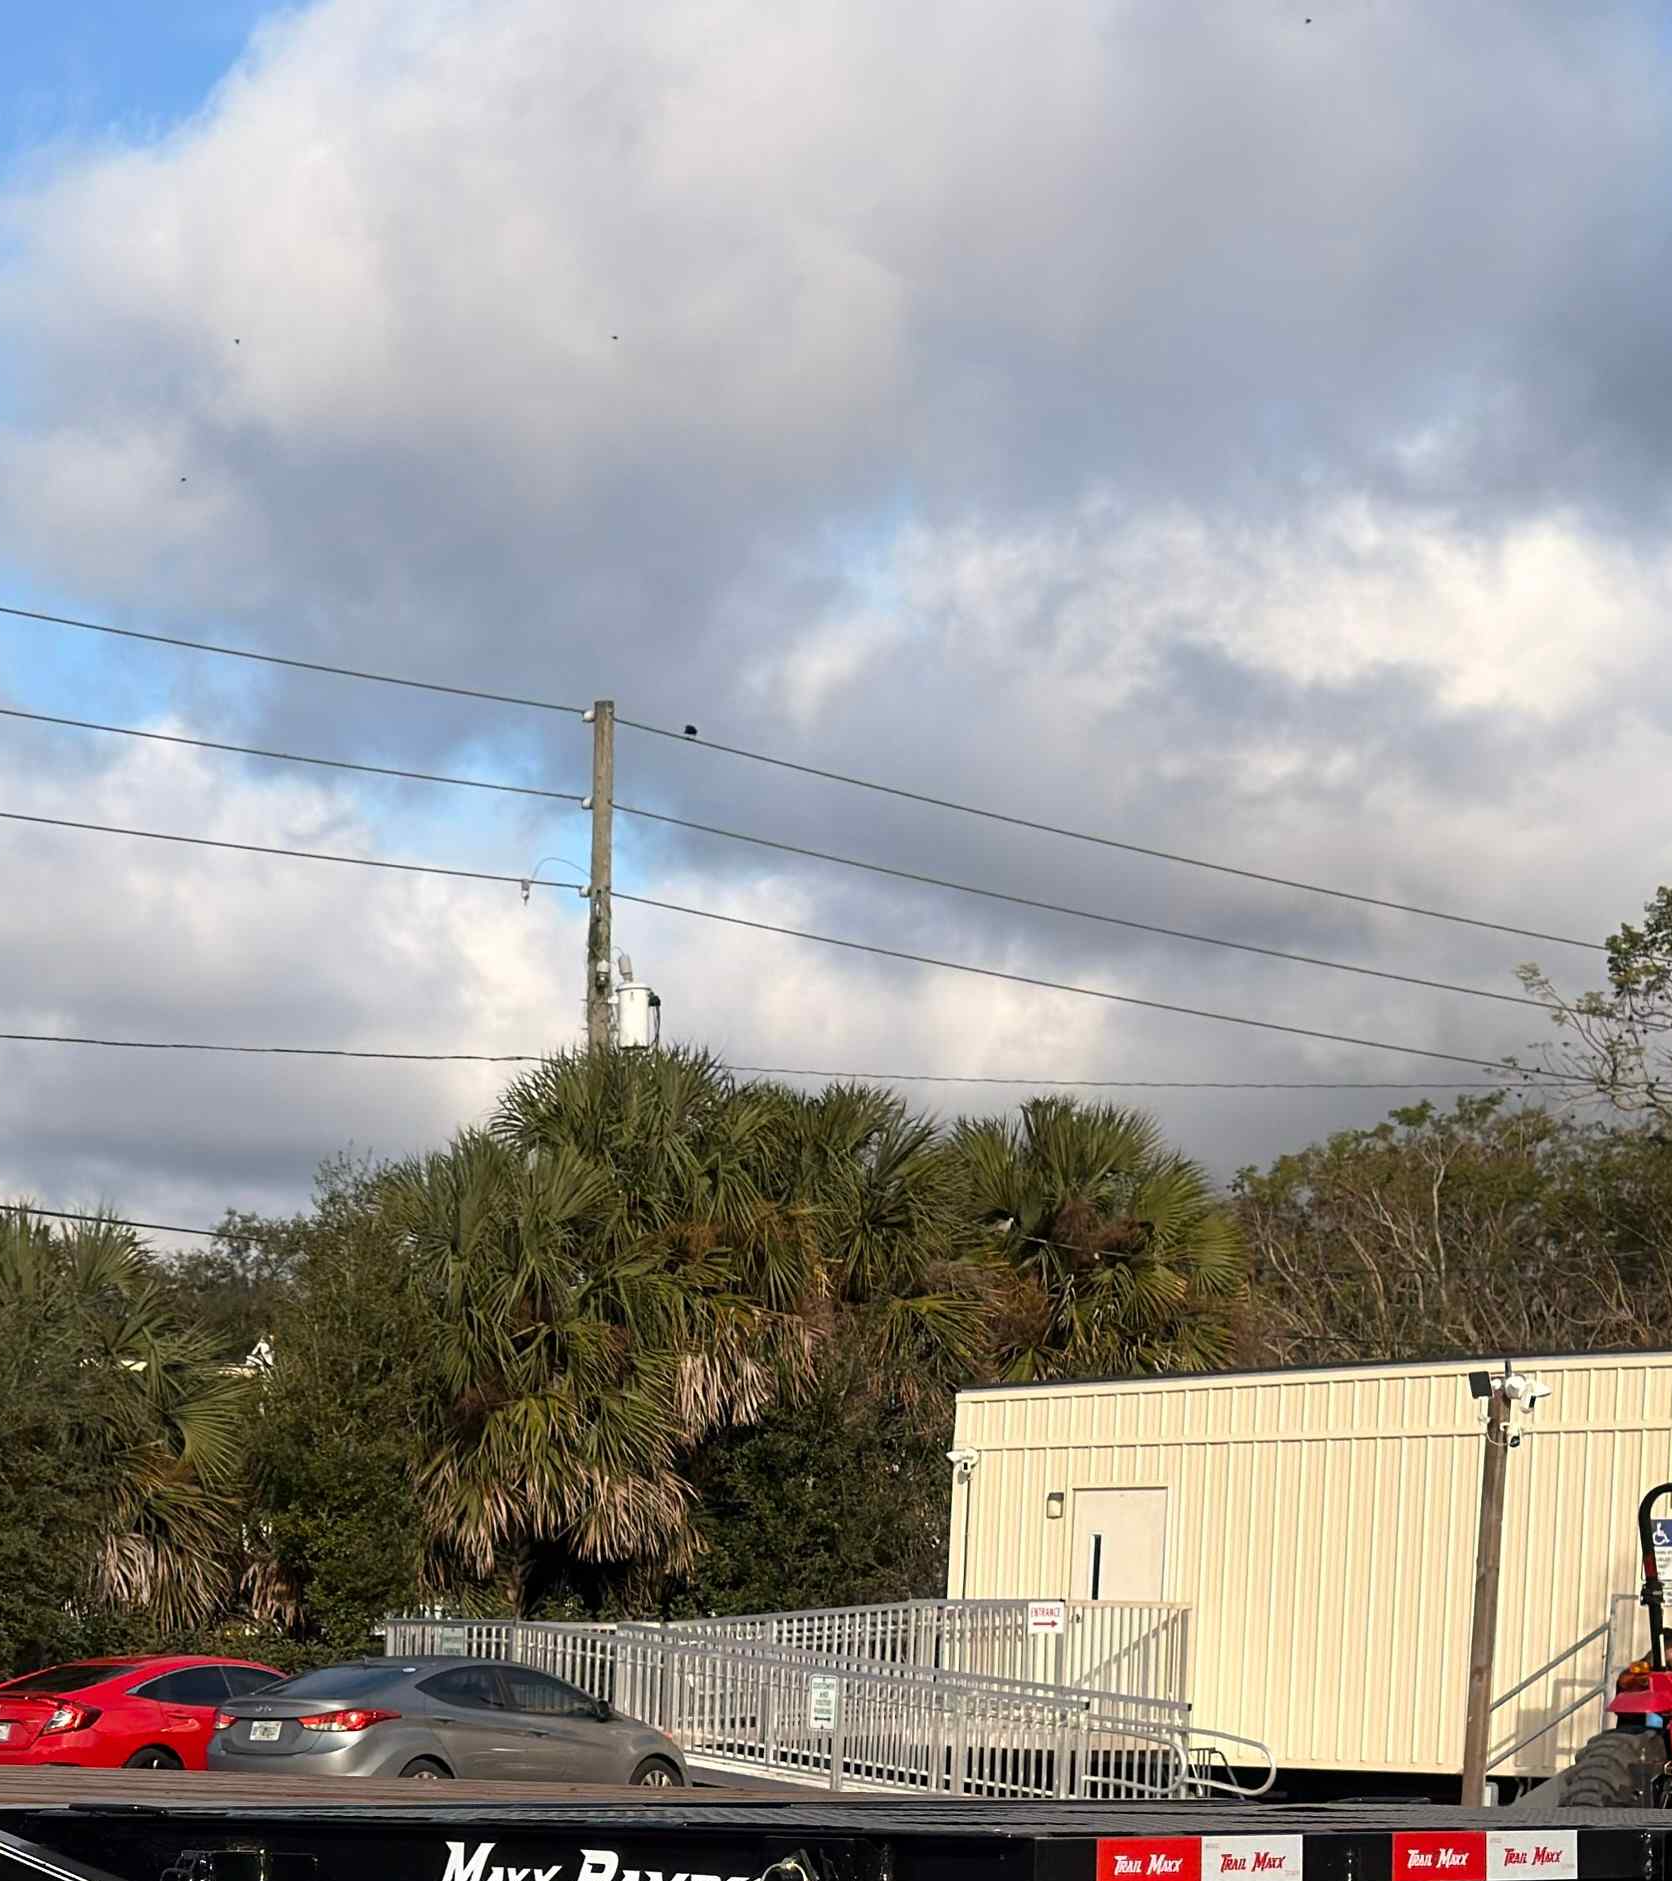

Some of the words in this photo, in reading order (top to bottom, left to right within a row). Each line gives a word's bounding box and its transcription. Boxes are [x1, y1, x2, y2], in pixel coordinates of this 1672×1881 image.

[1114, 1855, 1142, 1875] TRAIL
[1146, 1854, 1183, 1875] MAXX
[1221, 1854, 1247, 1873] TRAIL
[1251, 1851, 1286, 1872] MAXX
[1407, 1849, 1432, 1868] TRAIL
[1436, 1848, 1469, 1868] MAXX
[1504, 1848, 1528, 1866] TRAIL
[1532, 1846, 1563, 1865] MAXX
